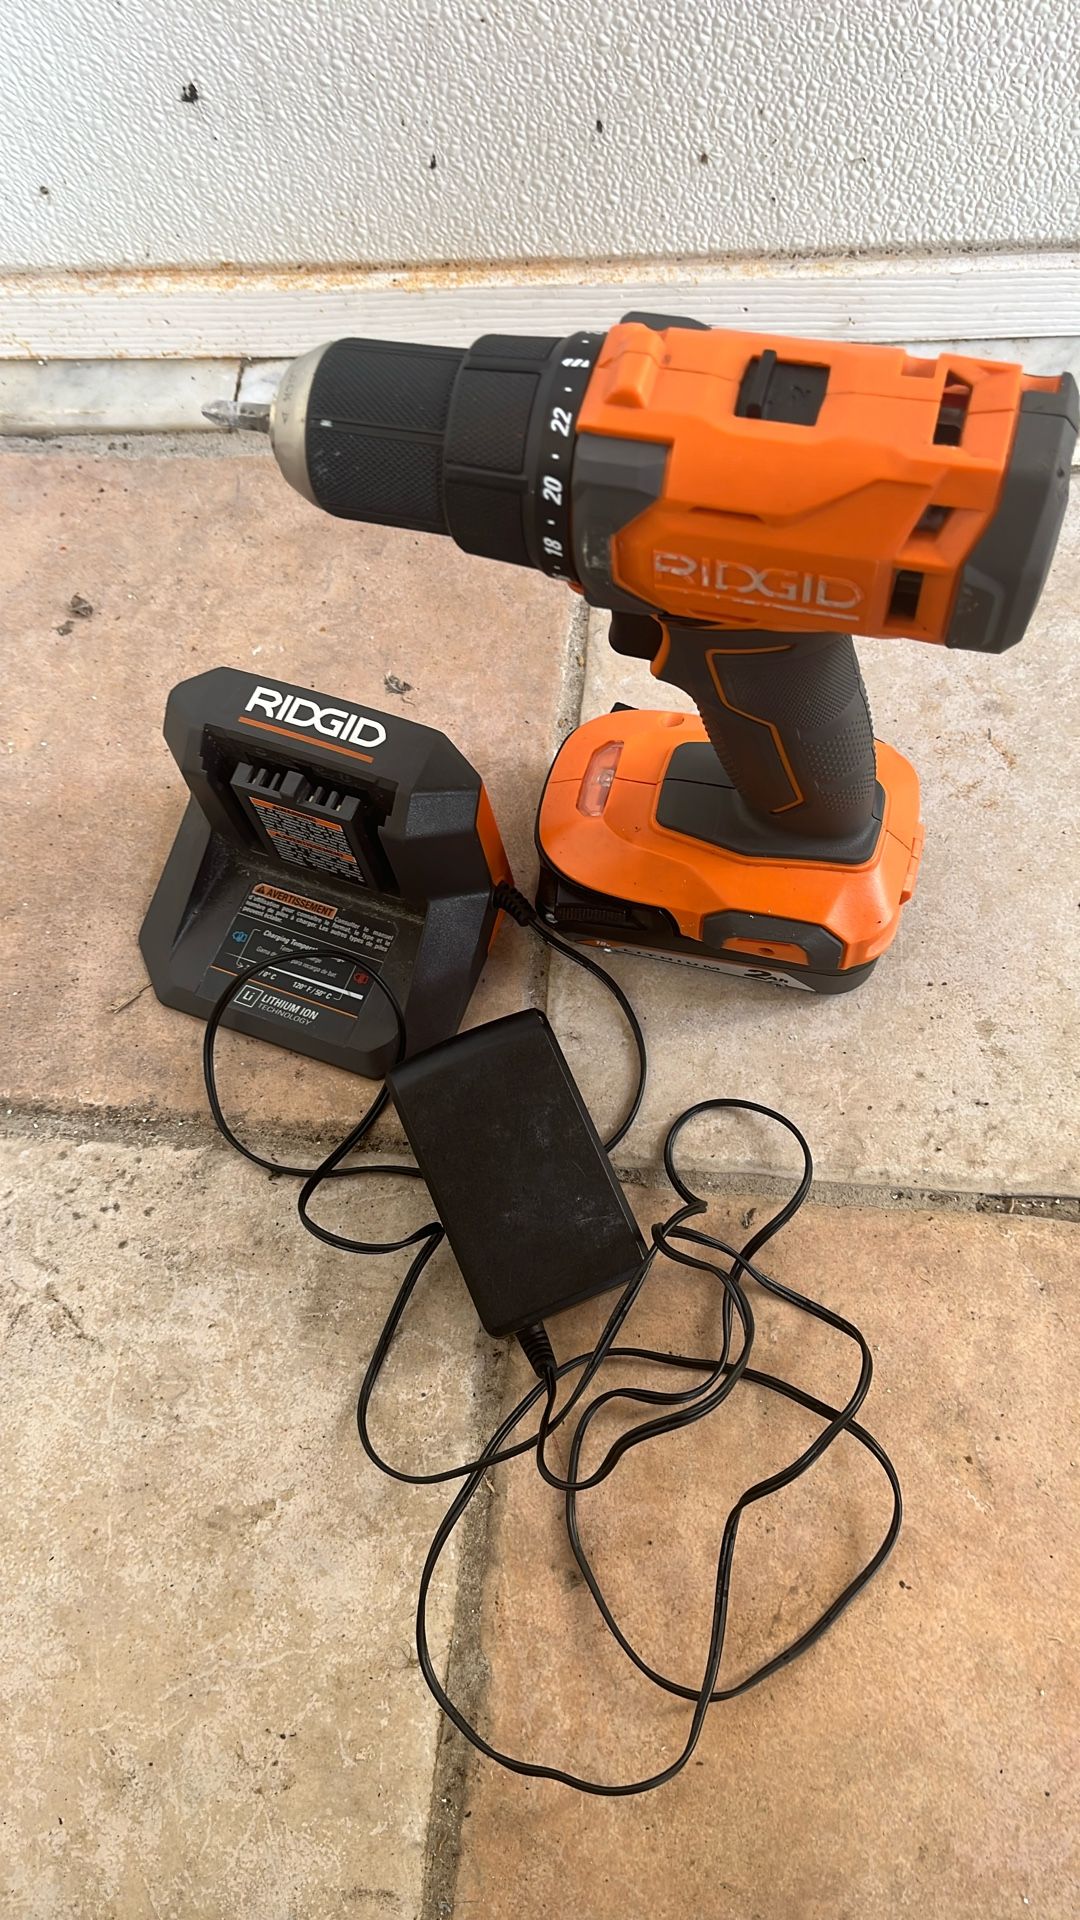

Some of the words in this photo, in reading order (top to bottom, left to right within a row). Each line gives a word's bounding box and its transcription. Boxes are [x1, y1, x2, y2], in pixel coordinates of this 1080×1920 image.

[550, 407, 572, 437] 22
[543, 476, 563, 506] 20
[543, 537, 563, 558] 18
[654, 551, 864, 609] RIDGID
[245, 686, 387, 748] RIDGID
[265, 889, 334, 917] AVERTISSEMENT
[334, 916, 361, 930] Consulter
[372, 930, 394, 941] manuel
[263, 929, 291, 945] Charging
[242, 990, 256, 1001] Li
[261, 994, 302, 1014] LITHIUM
[299, 1007, 319, 1020] ION
[258, 1003, 313, 1026] TECHNOLOGY
